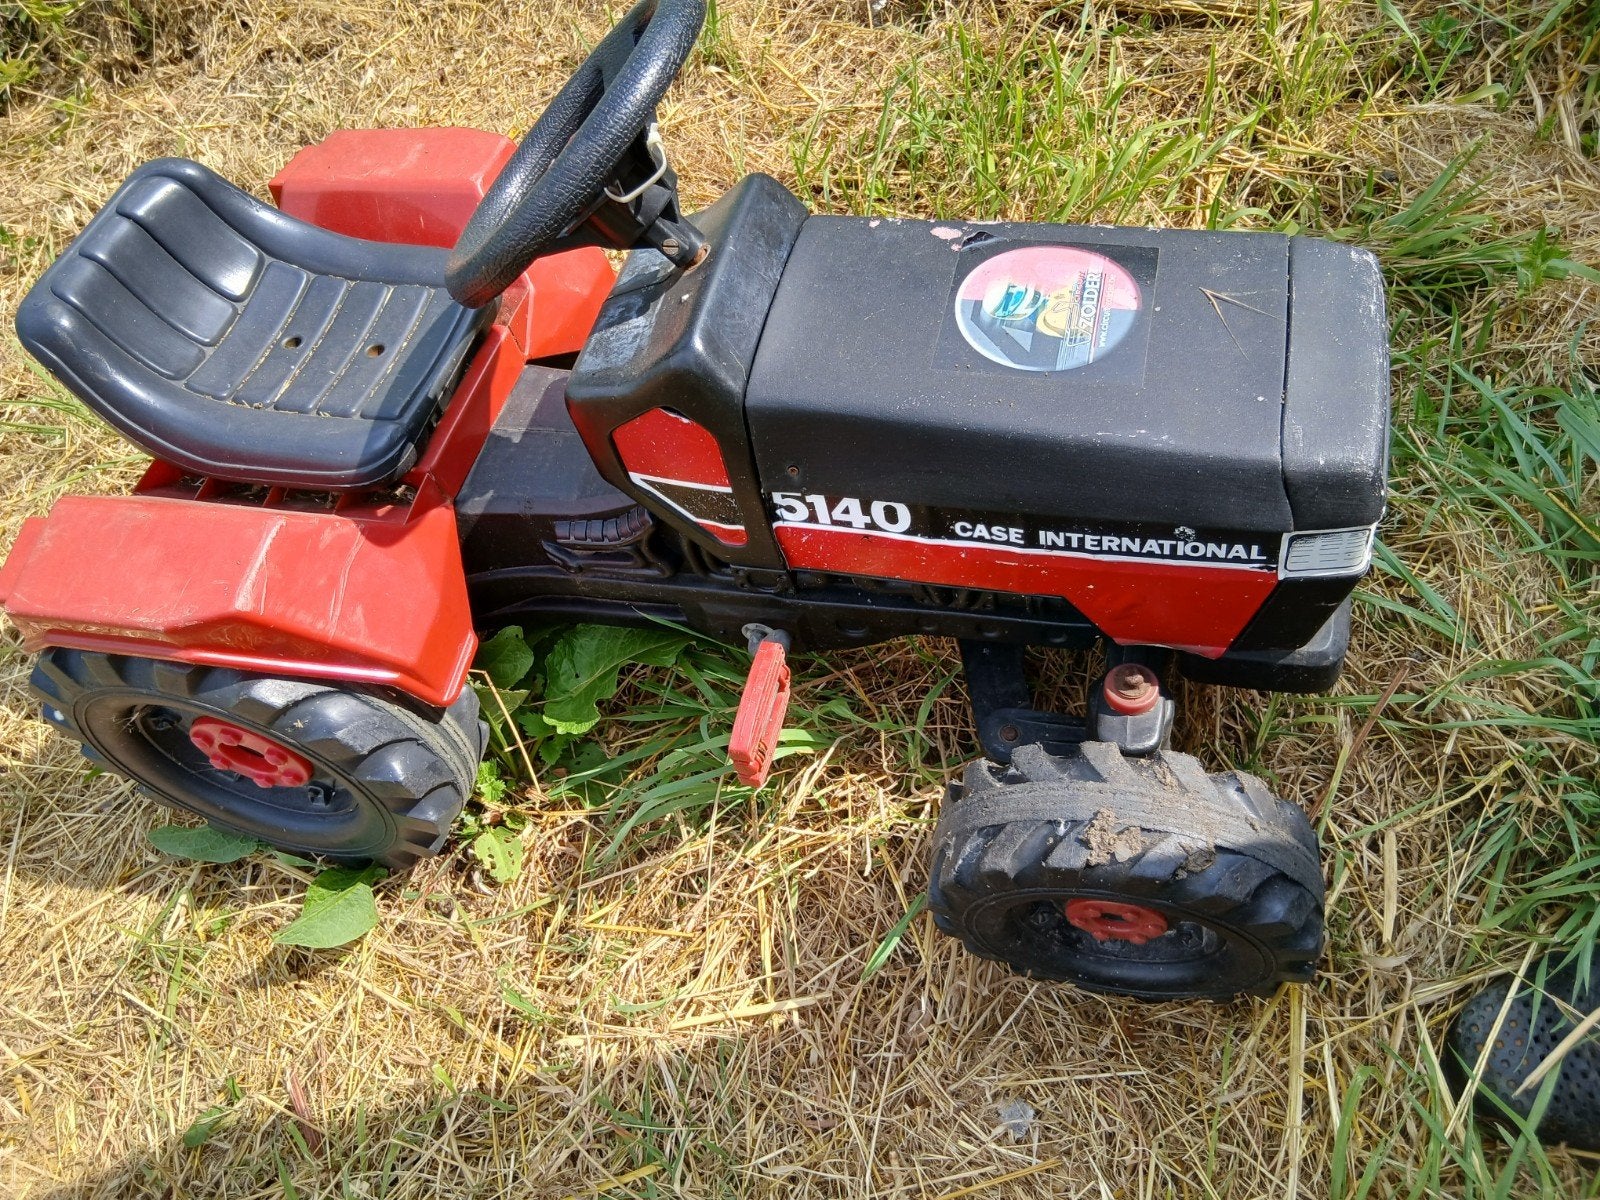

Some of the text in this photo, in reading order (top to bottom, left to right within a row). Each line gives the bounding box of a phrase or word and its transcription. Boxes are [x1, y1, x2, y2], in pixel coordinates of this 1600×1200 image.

[1078, 272, 1101, 330] ZOLDER
[771, 491, 912, 533] 5140
[954, 521, 1267, 561] CASE INTERNATIONAL
